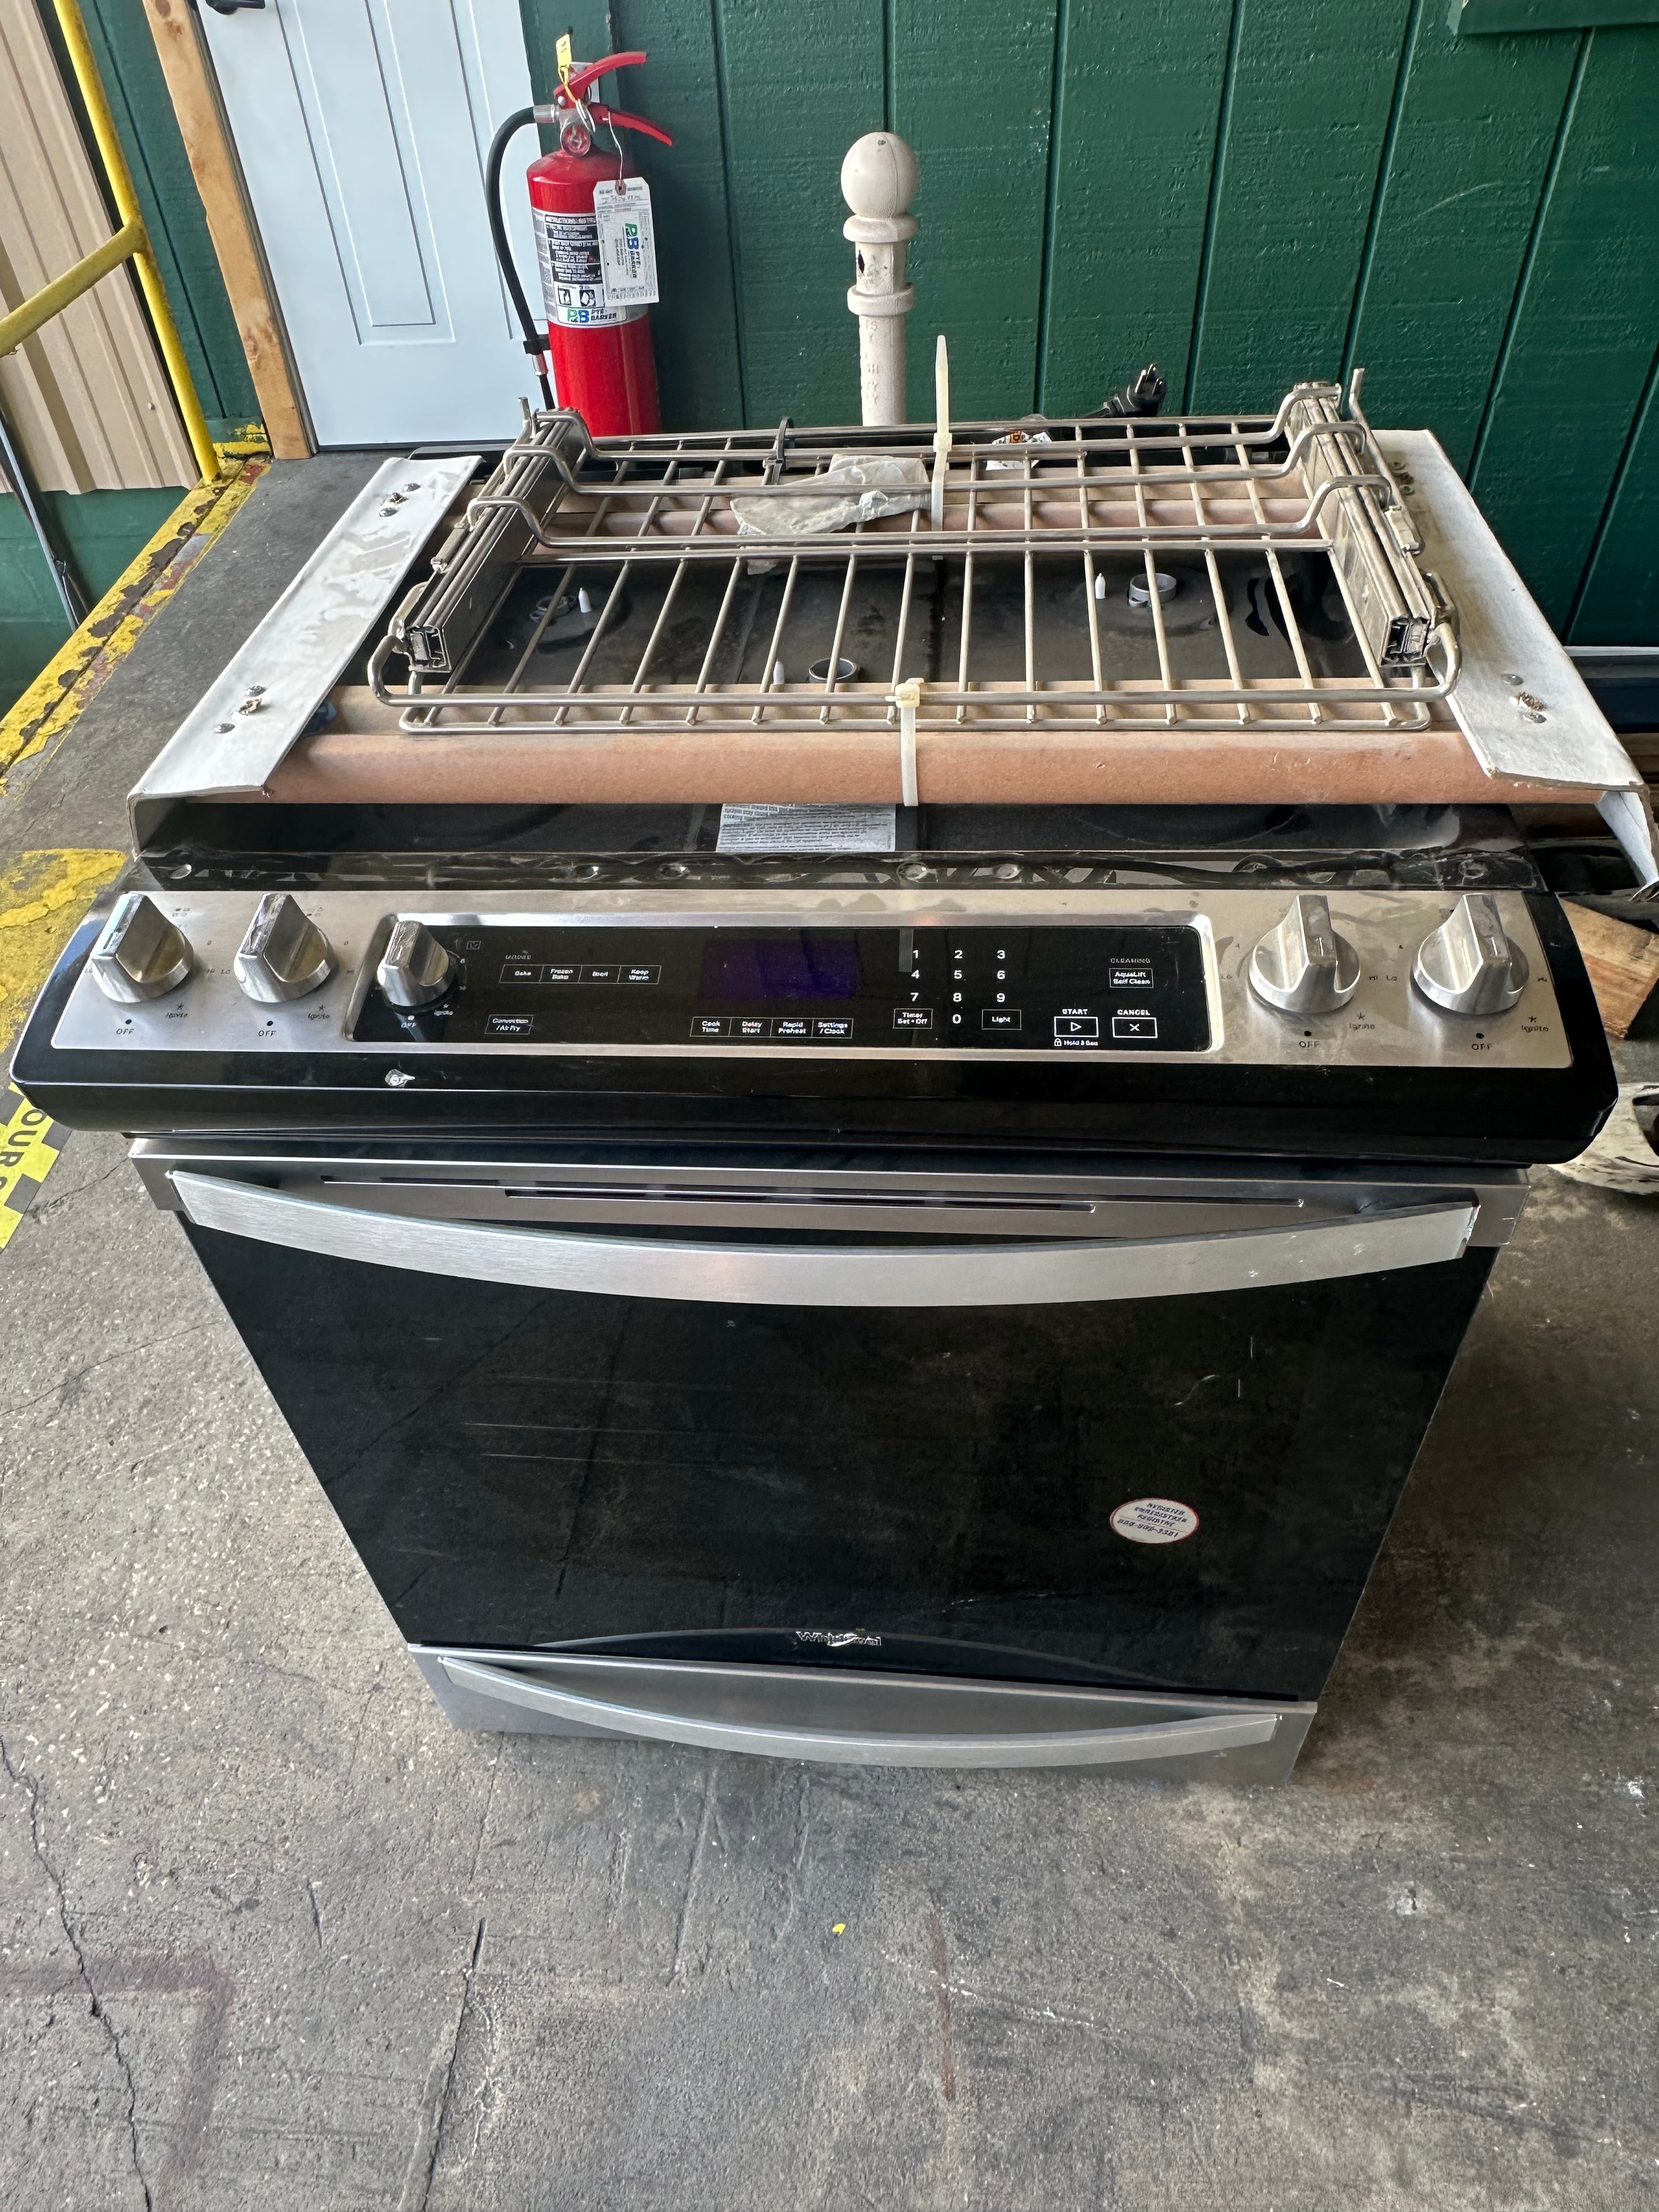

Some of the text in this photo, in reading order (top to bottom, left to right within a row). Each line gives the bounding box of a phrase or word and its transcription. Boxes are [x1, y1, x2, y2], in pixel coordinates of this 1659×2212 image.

[913, 950, 918, 958] 1
[954, 950, 963, 959] 2
[997, 950, 1005, 959] 3
[911, 970, 919, 979] 4
[954, 970, 962, 979] 5
[997, 970, 1005, 979] 6
[911, 992, 919, 1002] 7
[953, 992, 962, 1002] 8
[997, 993, 1005, 1002] 9
[952, 1014, 961, 1024] 0
